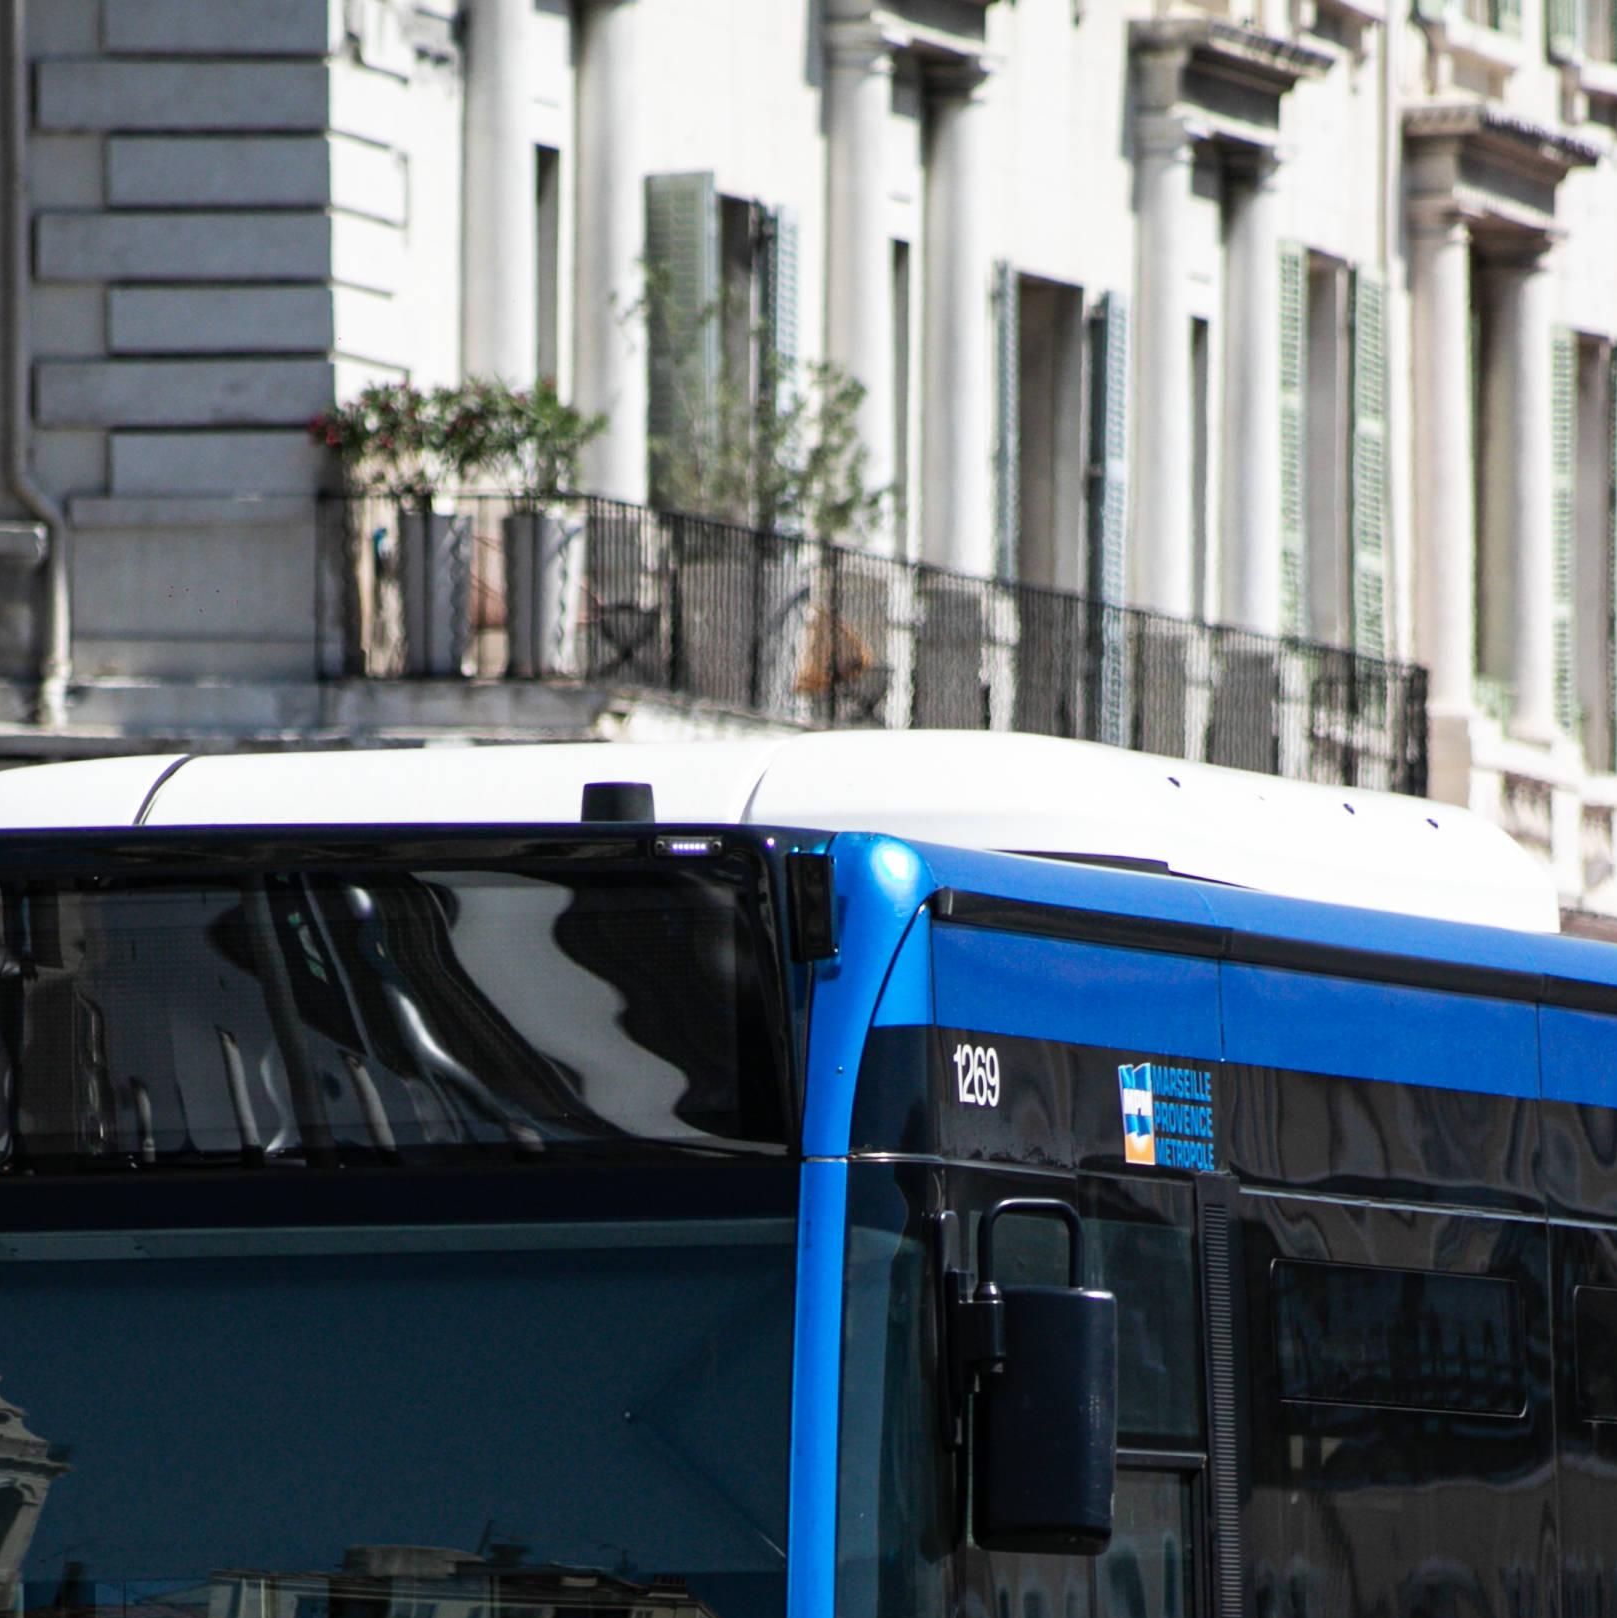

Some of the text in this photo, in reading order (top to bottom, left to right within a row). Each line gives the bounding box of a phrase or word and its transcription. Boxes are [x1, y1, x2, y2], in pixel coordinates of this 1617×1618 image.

[953, 1044, 1000, 1107] 1269
[1151, 1064, 1212, 1102] MARSEILLE
[1153, 1101, 1214, 1138] PROVENCE
[1155, 1137, 1215, 1172] METROPOLE
